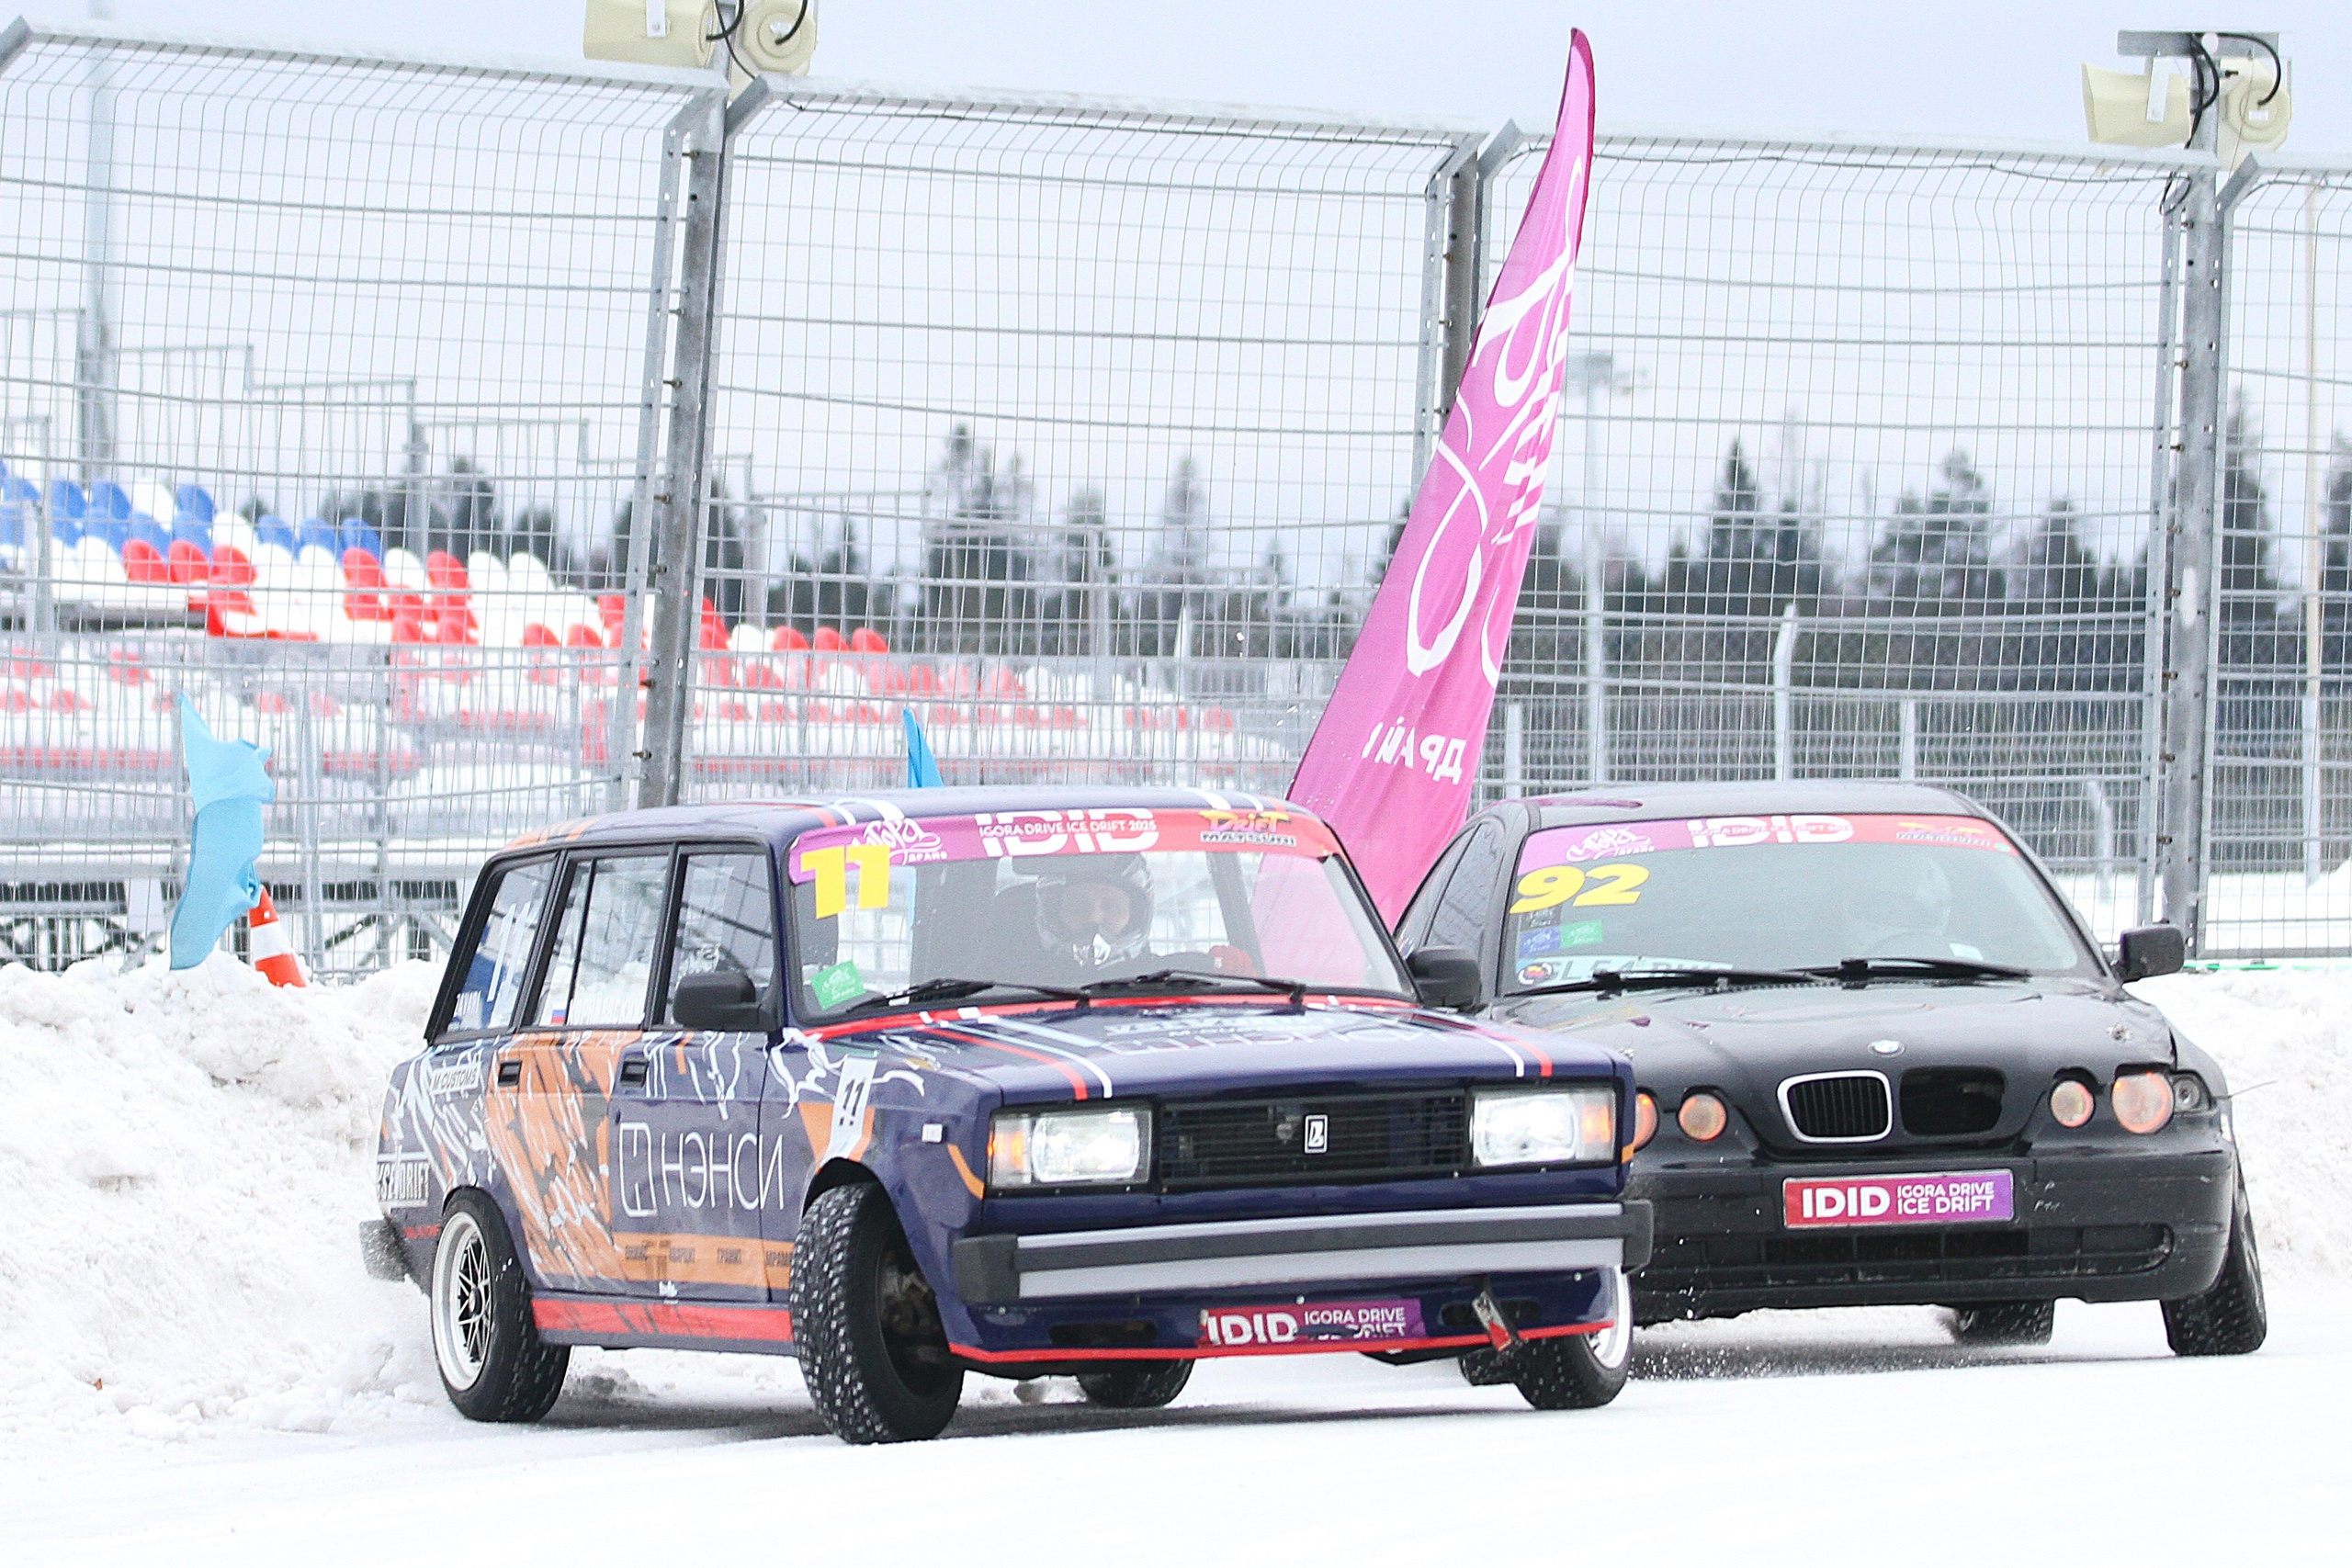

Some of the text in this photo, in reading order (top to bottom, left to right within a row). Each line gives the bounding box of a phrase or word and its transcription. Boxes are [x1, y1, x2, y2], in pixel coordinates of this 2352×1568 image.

[975, 807, 1159, 858] IDID
[979, 824, 1023, 837] IGORA
[1024, 822, 1066, 835] DRIVE
[1067, 821, 1088, 832] ICE
[1090, 819, 1126, 832] DRIFT
[1687, 815, 1854, 849] IDID
[800, 844, 891, 919] 11
[1510, 863, 1650, 914] 92
[661, 1131, 785, 1211] НЭНСИ
[1802, 1186, 1891, 1218] IDID
[1897, 1181, 1995, 1199] IGORA DRIVE
[1897, 1195, 1995, 1214] ICE DRIFT
[1207, 1312, 1298, 1345] IDID
[1305, 1306, 1405, 1325] IGORA DRIVE
